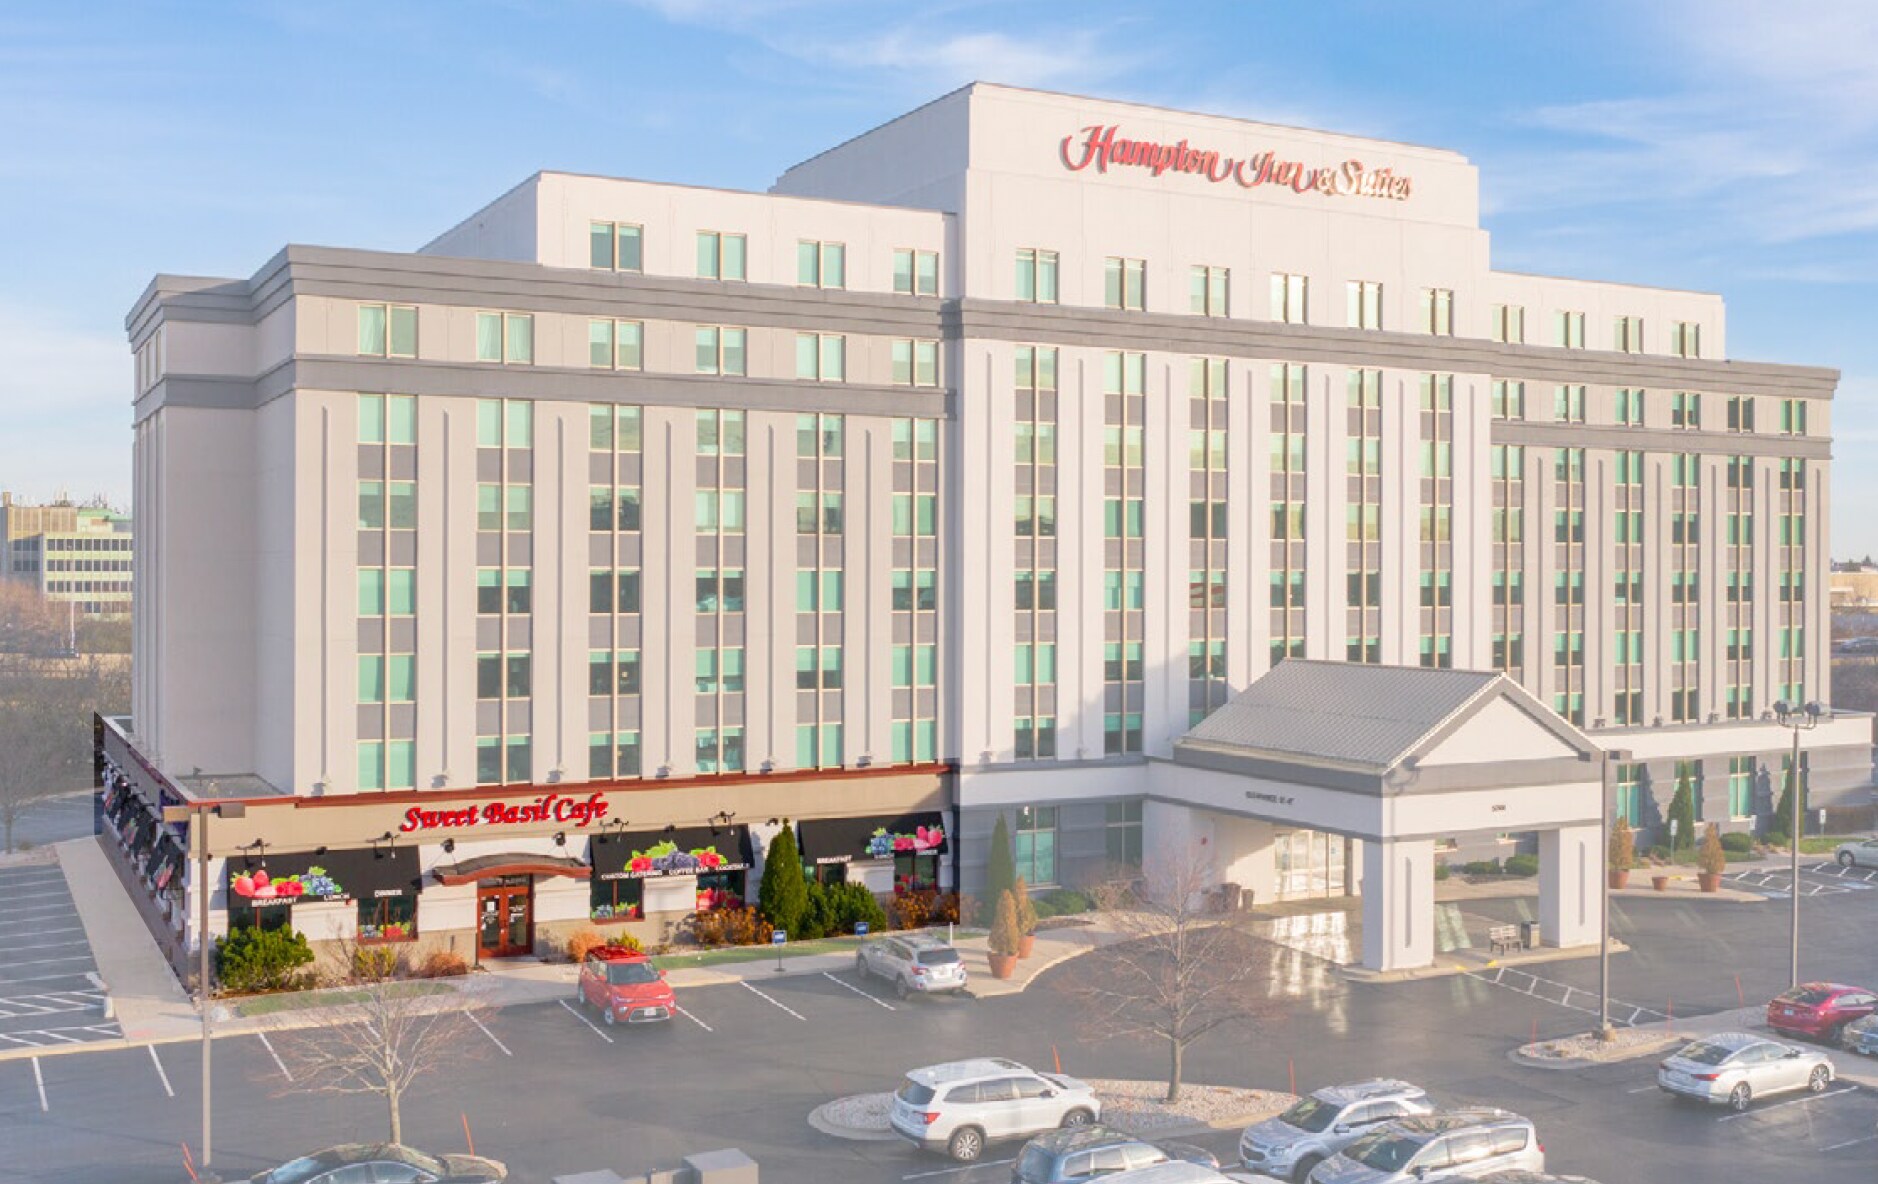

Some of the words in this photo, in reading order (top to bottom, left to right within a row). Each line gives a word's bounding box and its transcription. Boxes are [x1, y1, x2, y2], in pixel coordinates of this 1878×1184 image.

[1060, 125, 1234, 183] Hampton
[1233, 151, 1317, 194] Inn
[1338, 159, 1411, 200] Suites
[400, 804, 478, 832] Sweet
[483, 793, 558, 824] Basil
[554, 790, 609, 828] Cafe
[251, 897, 299, 908] BREAKFAST
